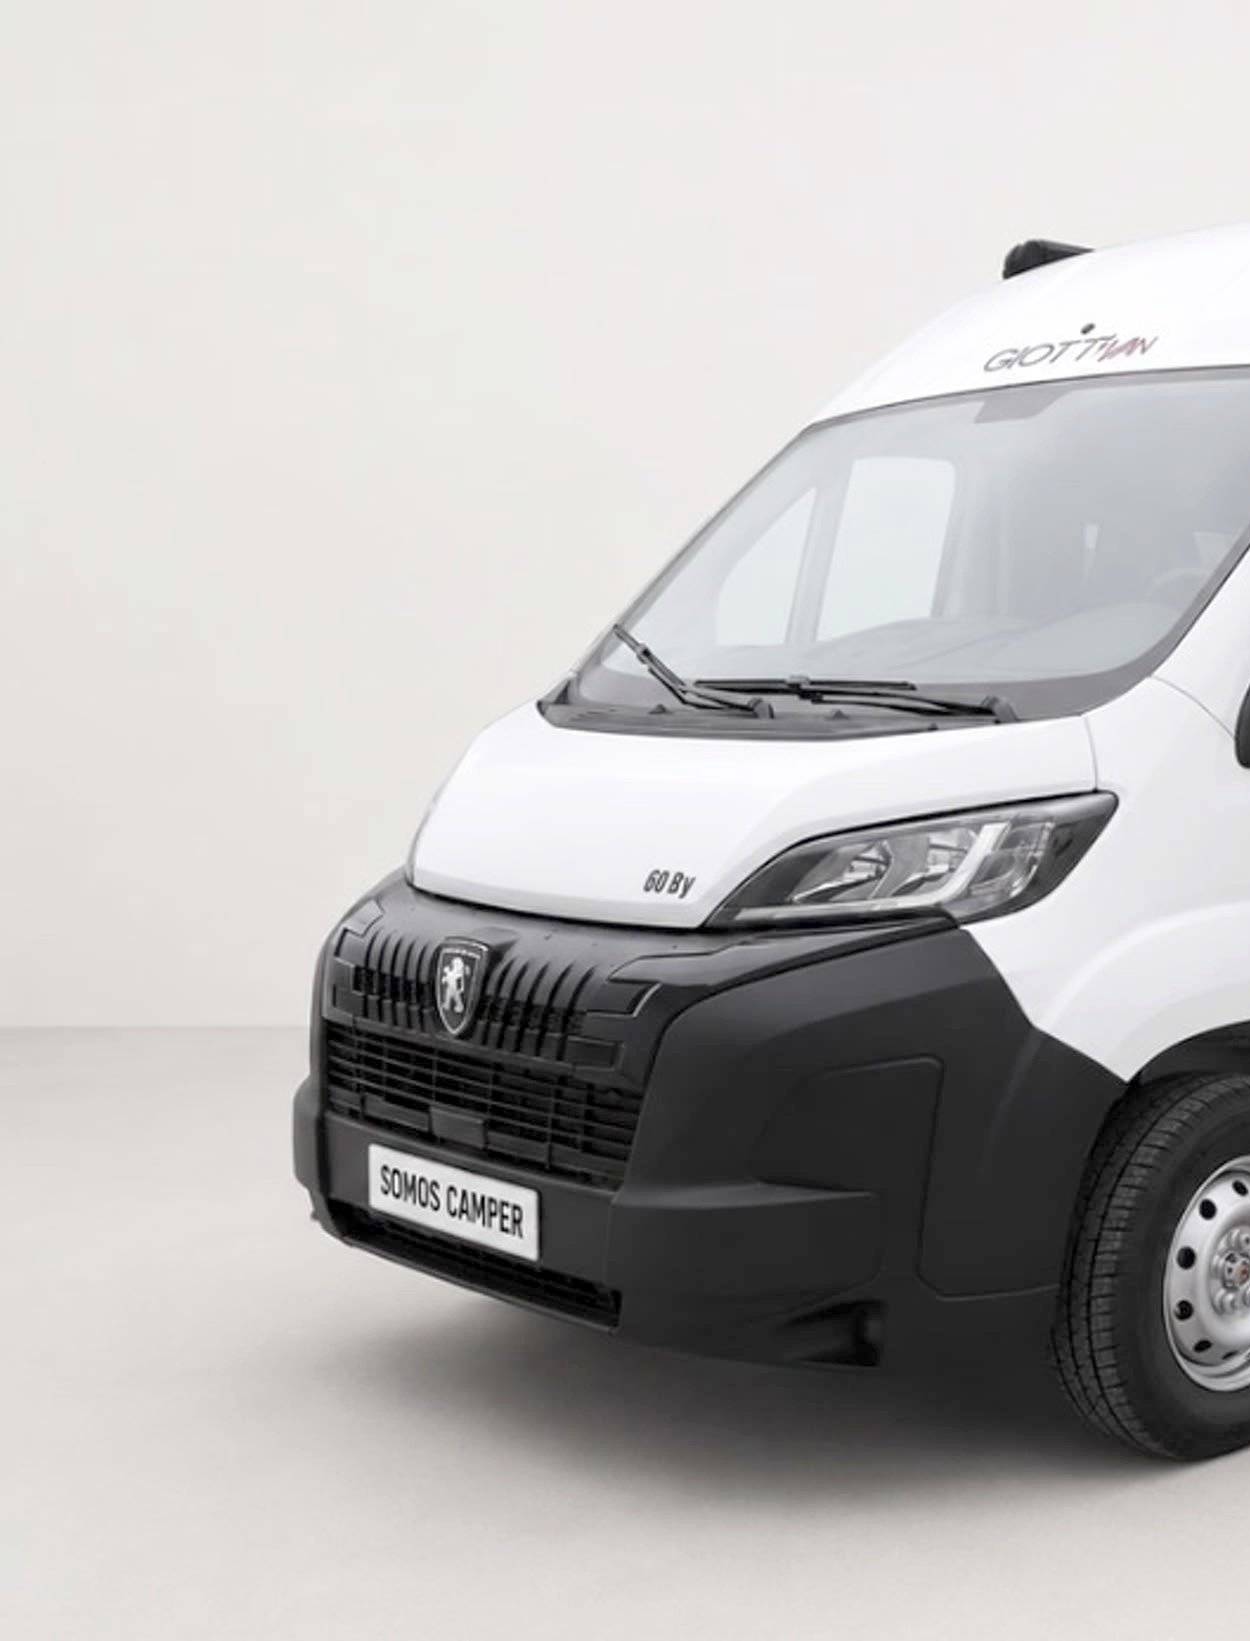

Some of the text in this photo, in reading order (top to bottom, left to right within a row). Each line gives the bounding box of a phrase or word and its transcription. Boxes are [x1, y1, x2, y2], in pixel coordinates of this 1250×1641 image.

[643, 869, 696, 899] 60 By
[380, 1164, 524, 1239] SOMOS CAMPER
